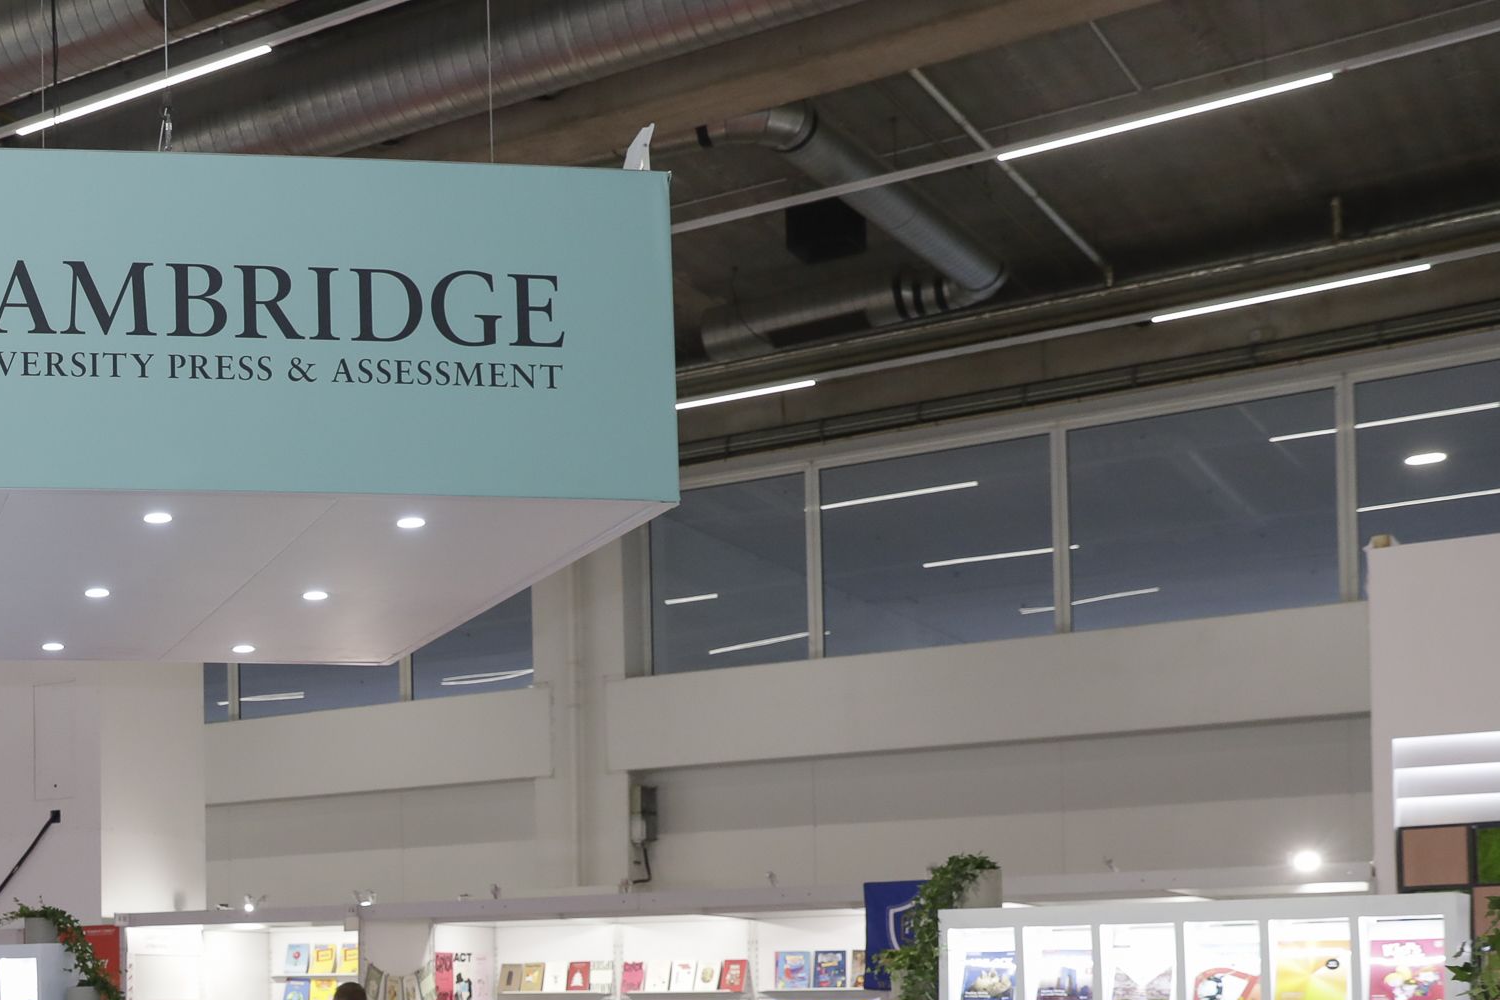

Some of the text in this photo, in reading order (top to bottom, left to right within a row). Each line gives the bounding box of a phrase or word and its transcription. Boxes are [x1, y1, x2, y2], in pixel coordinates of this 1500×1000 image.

[168, 353, 273, 382] PRESS
[288, 356, 317, 383] &
[332, 358, 564, 389] ASSESSMENT
[453, 953, 472, 962] ACT
